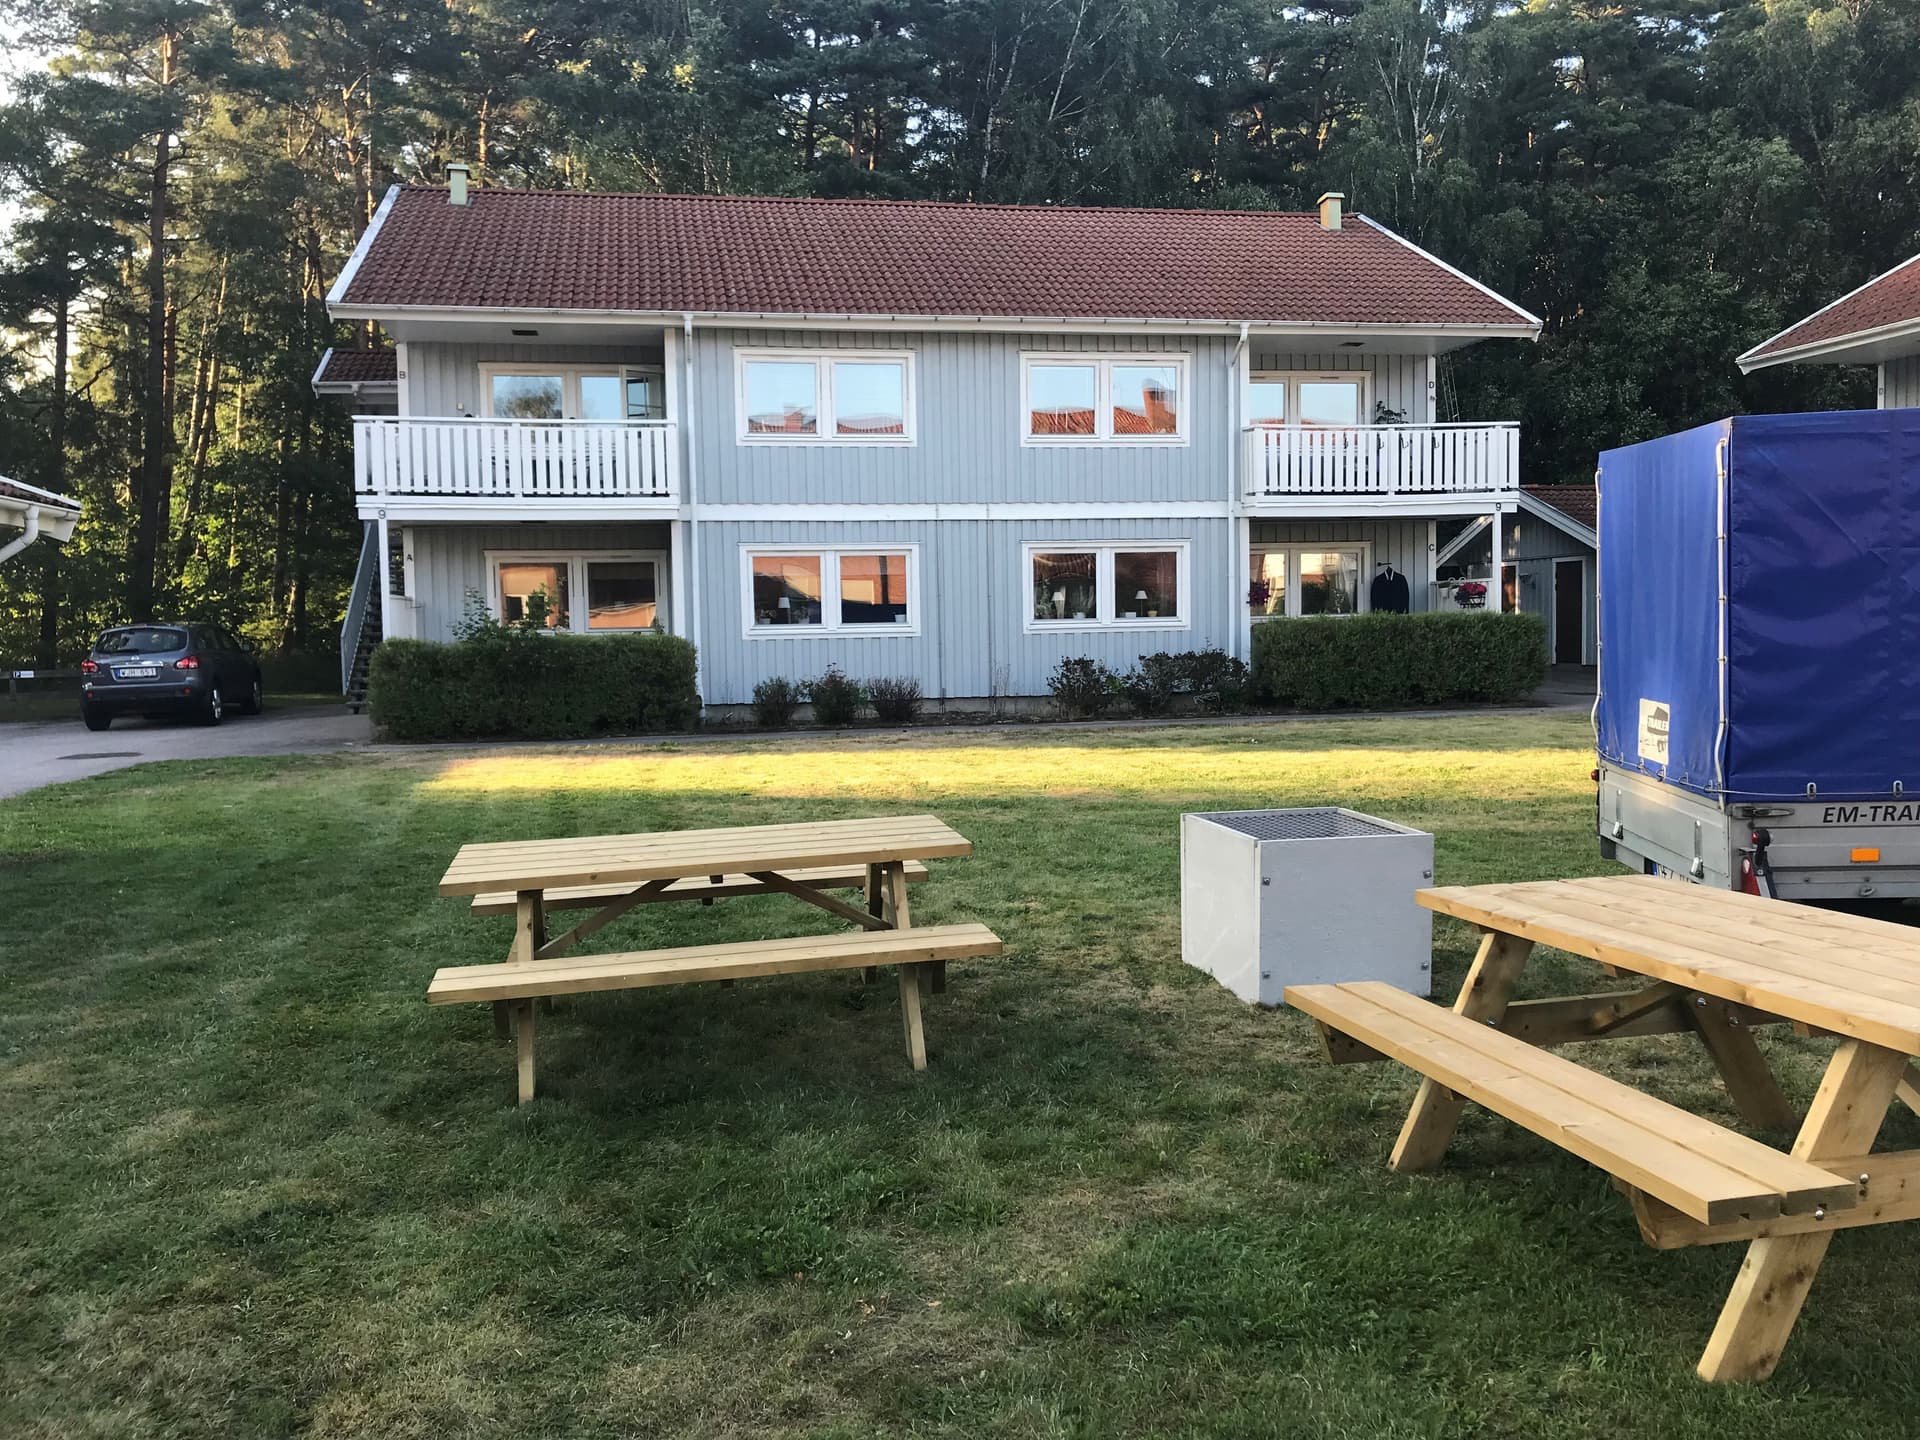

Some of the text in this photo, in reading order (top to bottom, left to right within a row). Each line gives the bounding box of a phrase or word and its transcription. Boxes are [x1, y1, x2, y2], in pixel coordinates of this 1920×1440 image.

[400, 370, 406, 379] B
[1429, 381, 1435, 389] D
[1495, 503, 1501, 511] 9
[378, 509, 386, 519] 9
[1428, 544, 1435, 552] C
[407, 553, 413, 561] A
